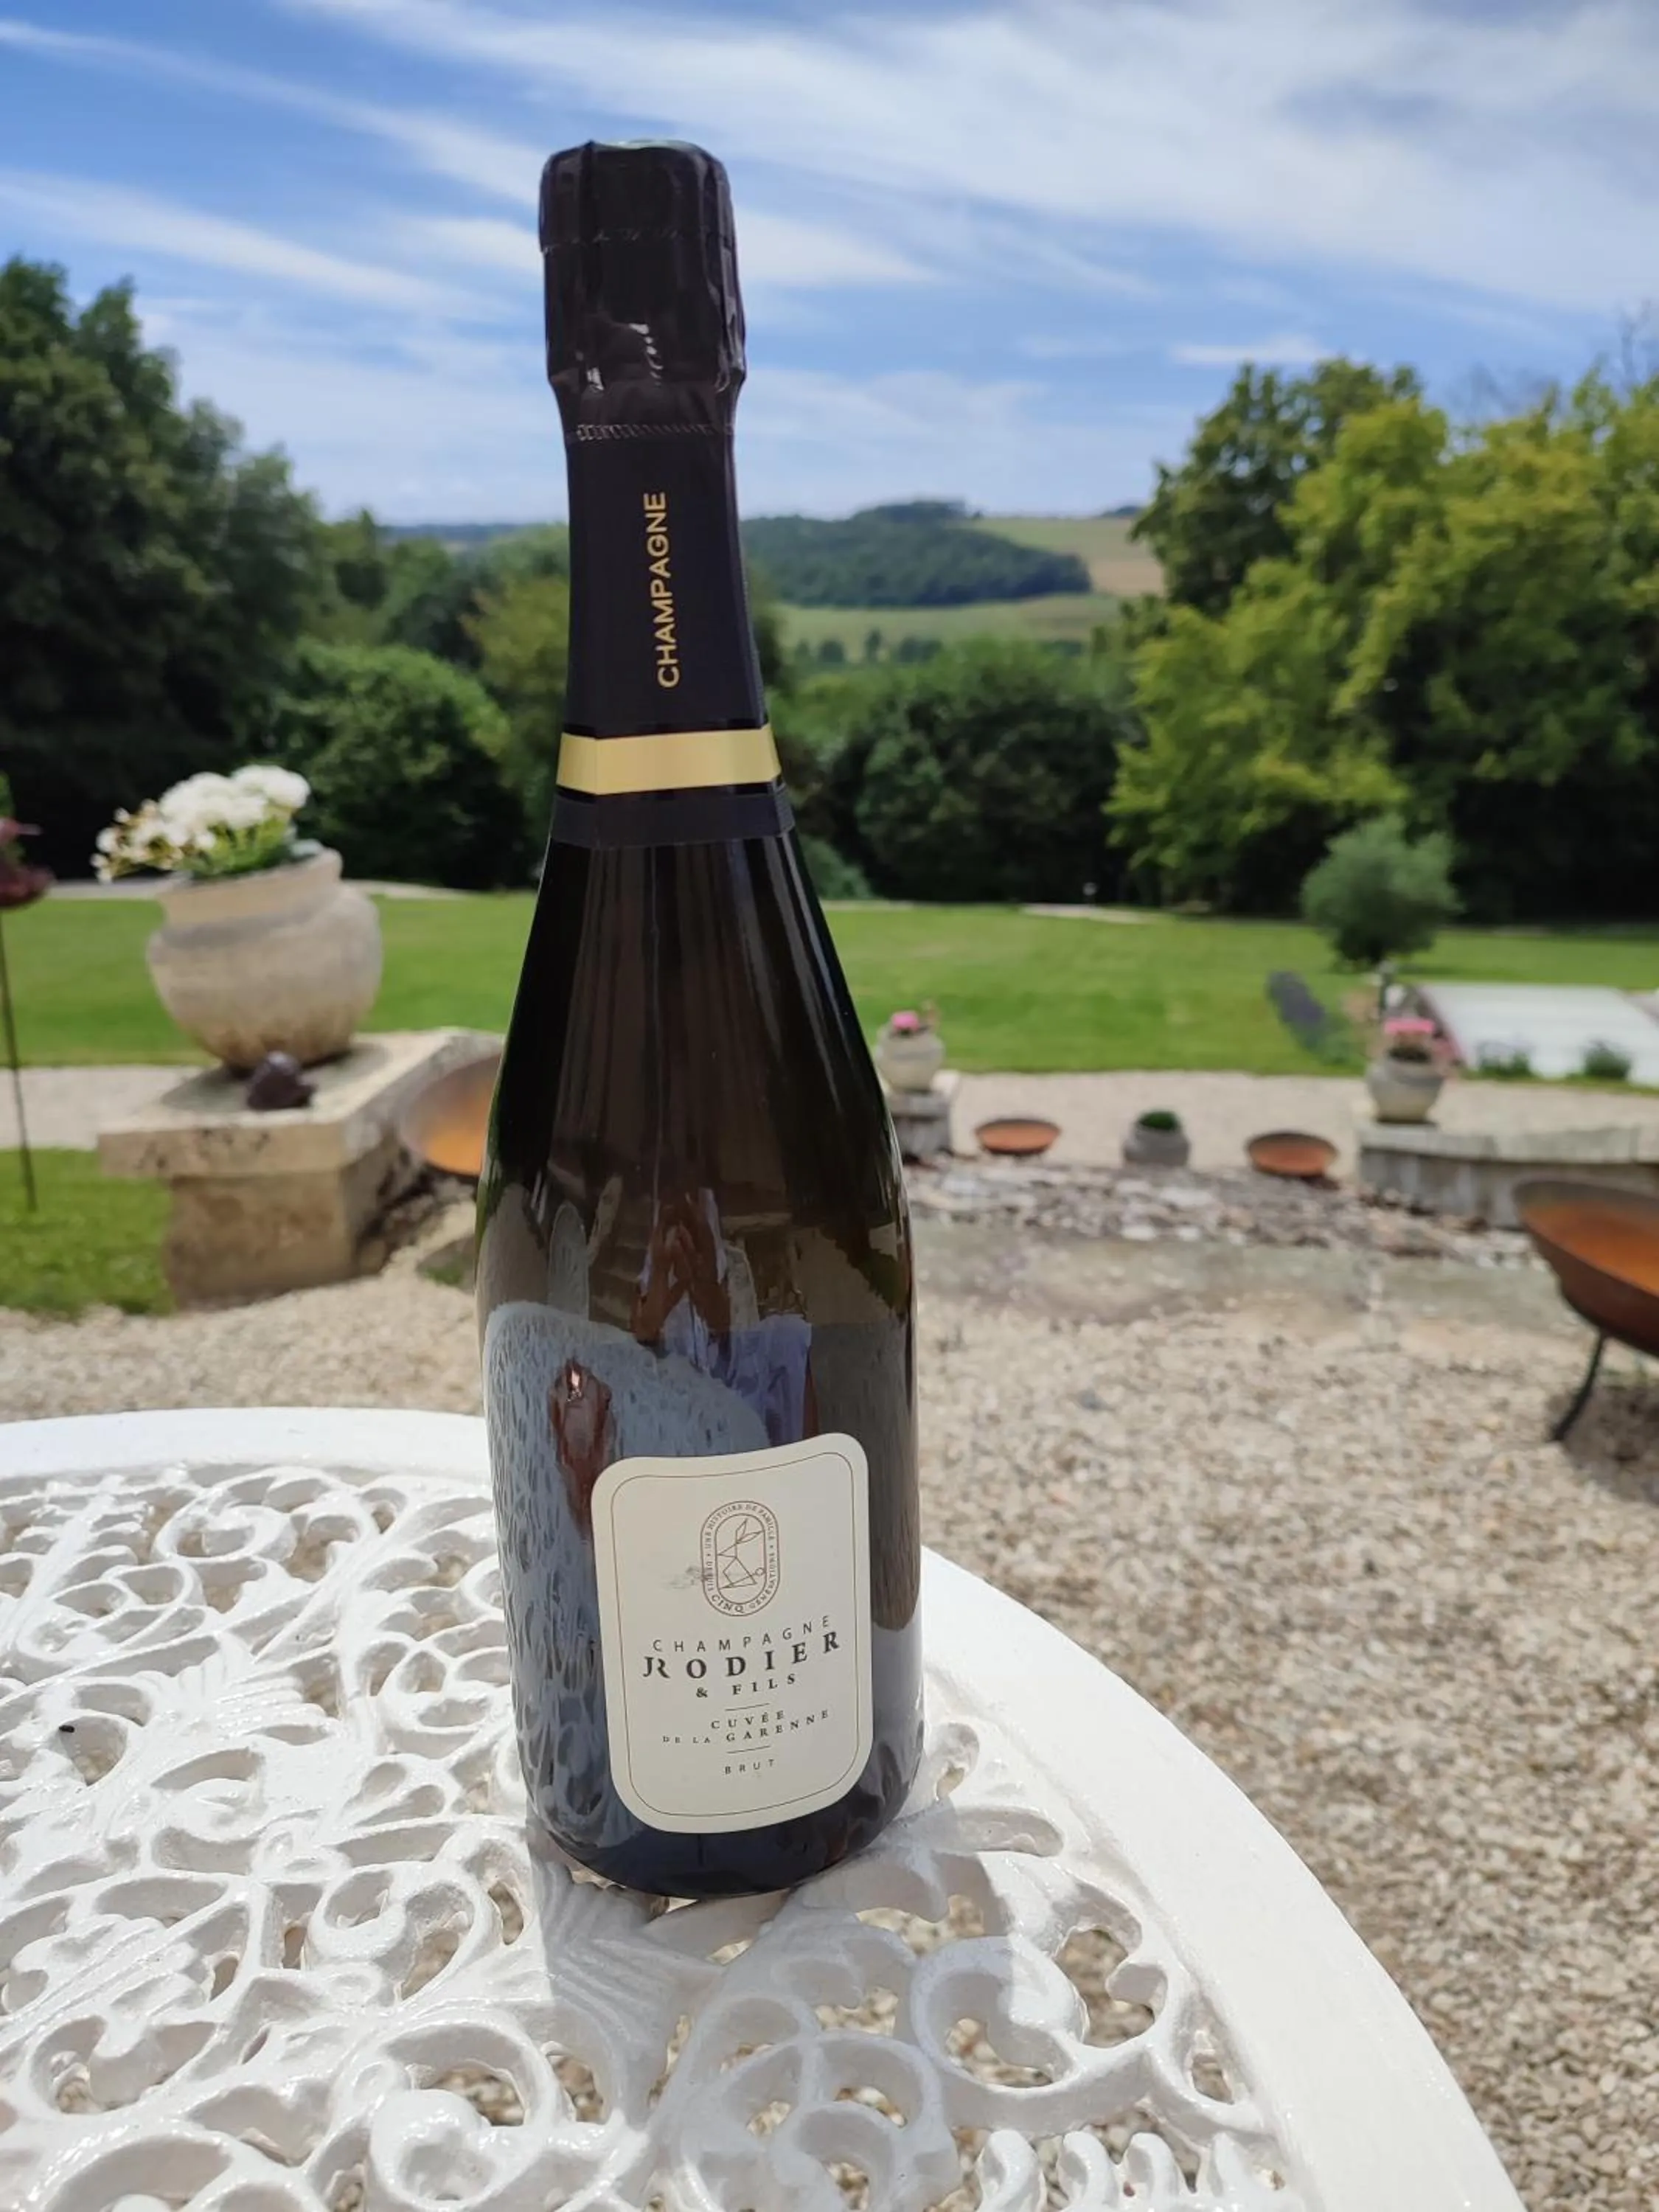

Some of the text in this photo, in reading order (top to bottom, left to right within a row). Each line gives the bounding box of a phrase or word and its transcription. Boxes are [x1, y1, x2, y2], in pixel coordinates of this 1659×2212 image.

[643, 492, 680, 687] CHAMPAGNE
[712, 1594, 745, 1613] CINQ
[653, 1615, 830, 1652] CHAMPAGNE
[696, 1673, 796, 1698] & FILS
[663, 1736, 681, 1744] DE
[726, 1710, 829, 1742] GARENNE
[711, 1710, 784, 1729] CUVÉE
[725, 1759, 774, 1775] BRUT
